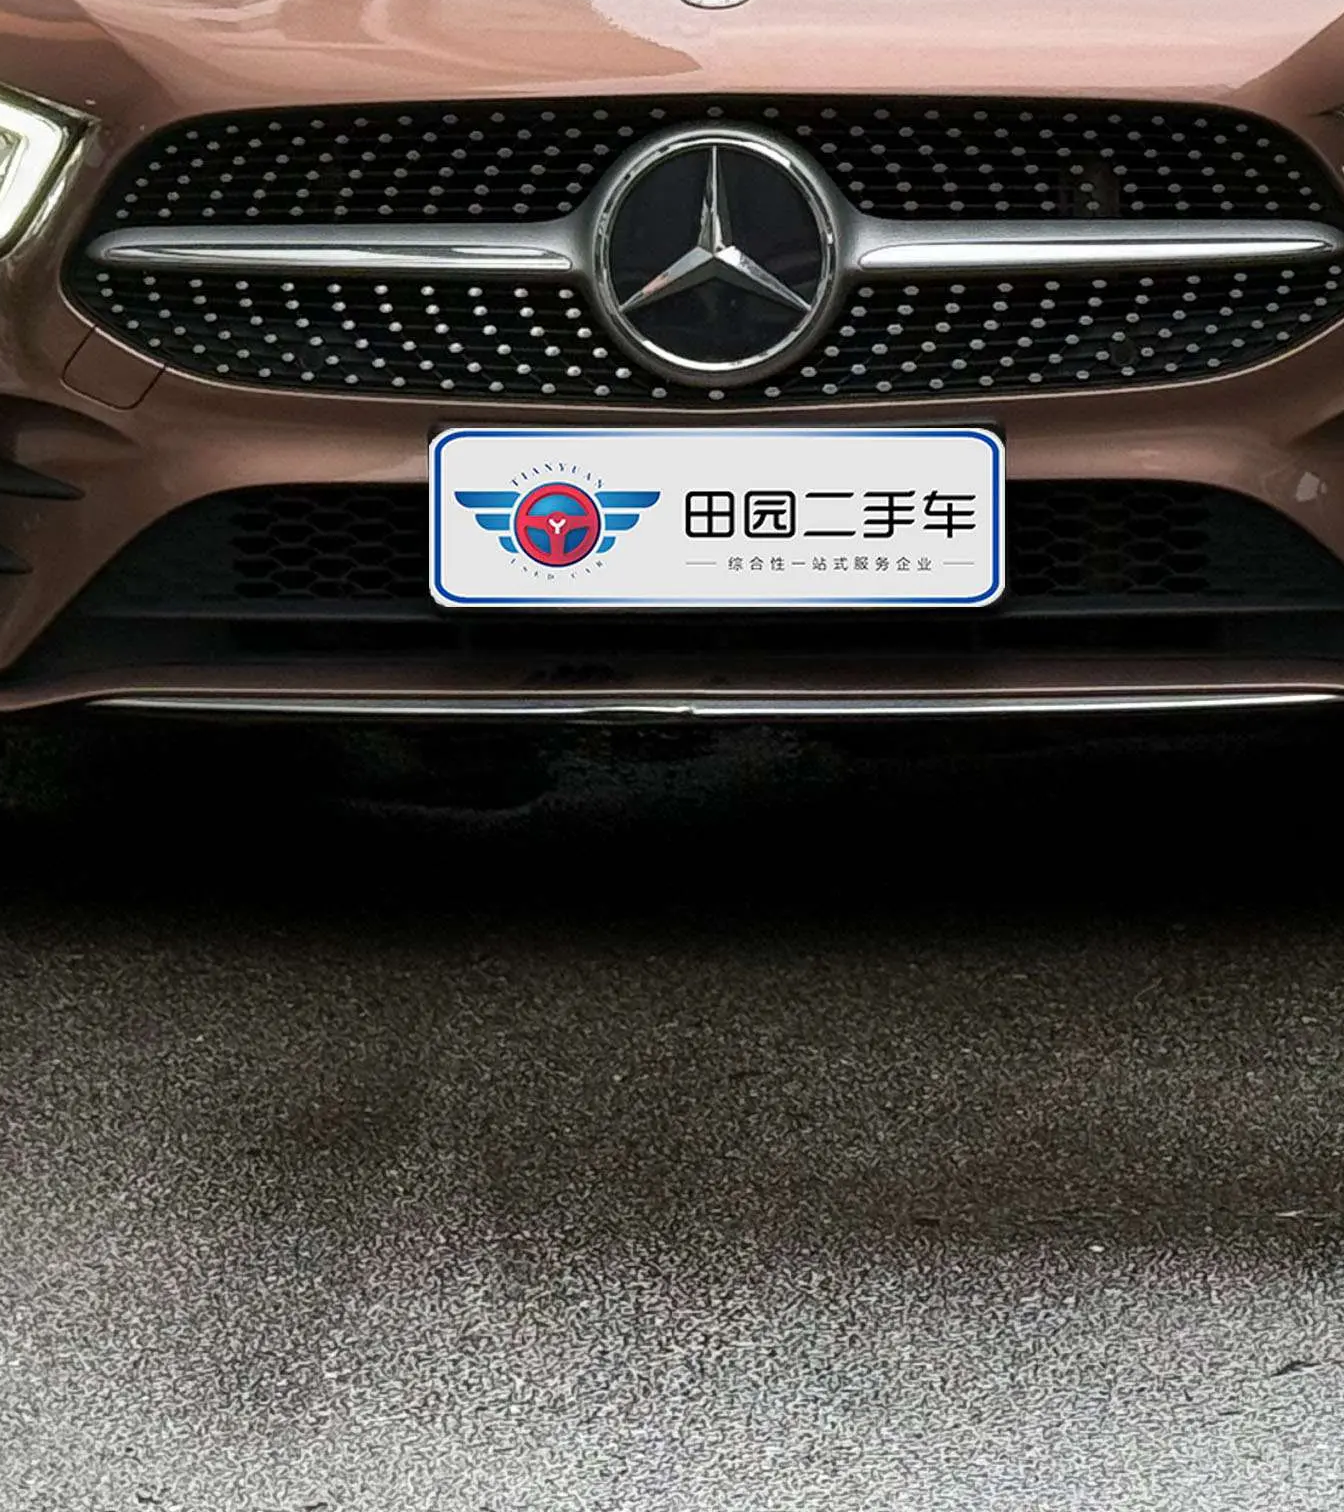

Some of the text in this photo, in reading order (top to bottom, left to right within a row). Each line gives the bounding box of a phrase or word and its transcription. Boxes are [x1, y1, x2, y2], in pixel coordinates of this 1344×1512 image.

[685, 490, 976, 538] 田园二手车
[727, 555, 932, 572] 综合性一站式服务企业
